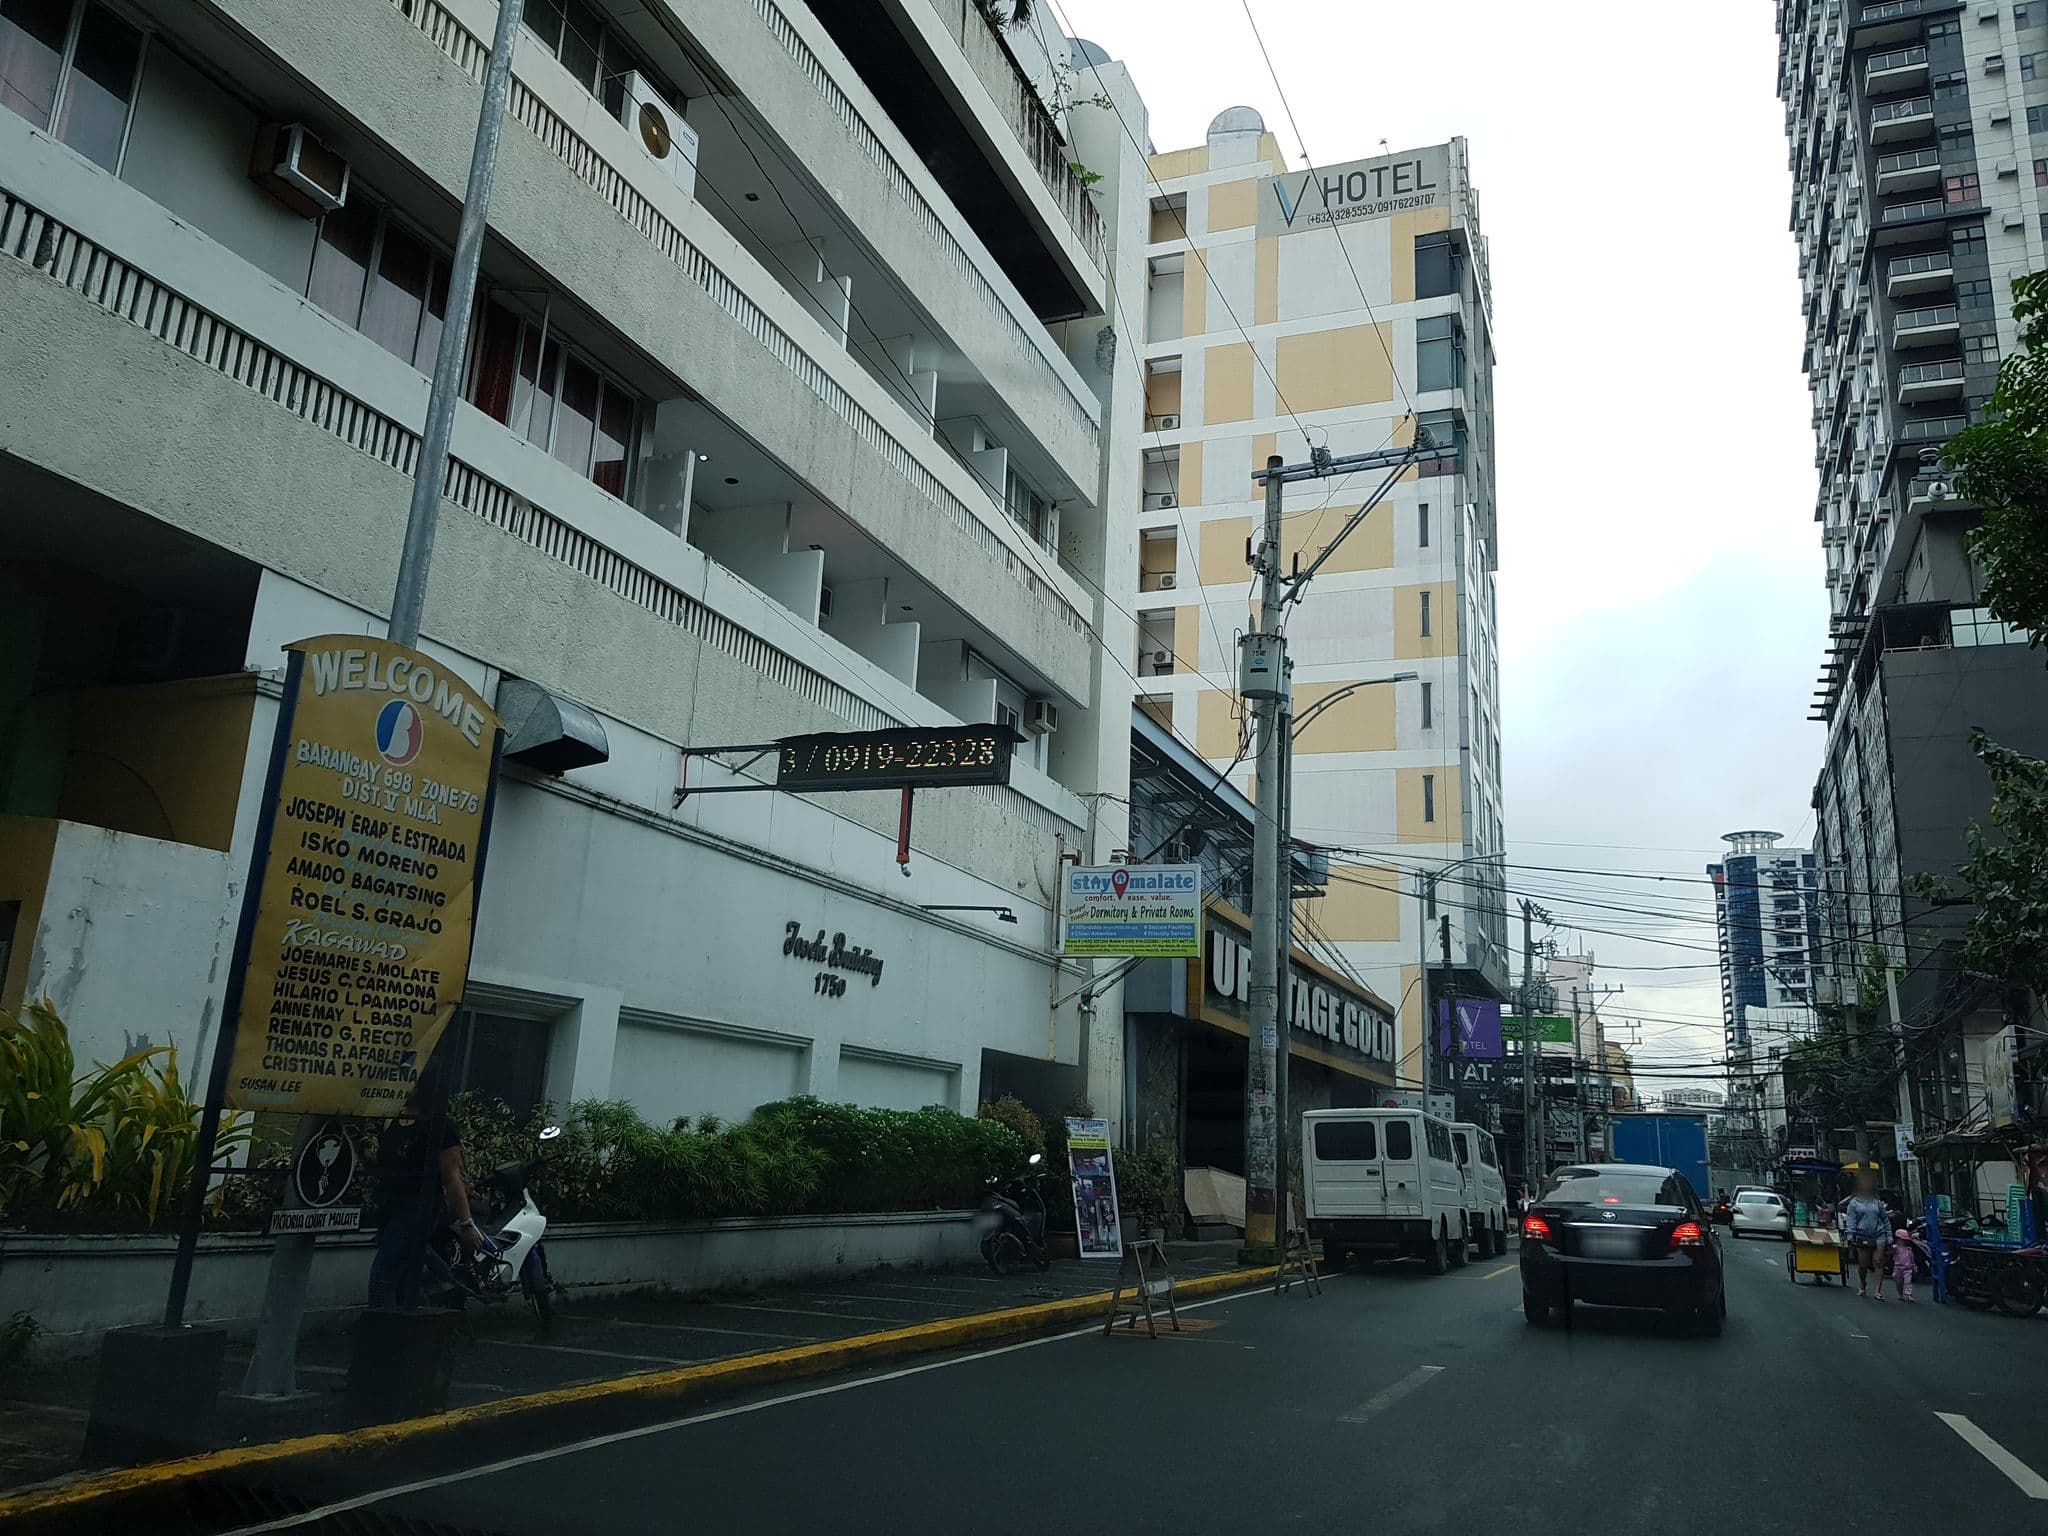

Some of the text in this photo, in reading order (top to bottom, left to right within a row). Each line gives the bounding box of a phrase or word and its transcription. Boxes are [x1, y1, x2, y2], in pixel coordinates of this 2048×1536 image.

[1272, 160, 1436, 228] V HOTEL
[312, 649, 486, 748] WELCOME
[296, 739, 381, 783] BARANGAY
[383, 769, 413, 794] 698
[285, 797, 346, 829] JOSEPH
[343, 777, 381, 808] DIST.
[404, 797, 442, 825] MLA.
[301, 831, 439, 880] ISKO MORENO
[286, 857, 447, 907] AMADO BAGATSING
[1072, 873, 1194, 892] stay malate
[290, 886, 442, 935] ROEL S. GRAJO
[1090, 905, 1194, 922] Dormitory & Private Rooms
[281, 918, 408, 961] KAGAWAD
[281, 946, 360, 972] JOEMARIE
[273, 981, 339, 1004] HILARIO
[361, 993, 437, 1016] PAMPOLA
[277, 965, 332, 985] JESUS
[356, 975, 437, 1001] CARMONA
[813, 971, 847, 998] 1750
[268, 1017, 333, 1039] RENATO
[359, 1028, 413, 1047] RECTO
[371, 1011, 413, 1029] BASA
[1343, 1001, 1393, 1063] GOLD
[266, 1036, 328, 1058] THOMAS
[262, 1054, 336, 1076] CRISTINA
[239, 1077, 302, 1093] SUSAN LEE
[272, 1212, 359, 1230] VICTORIA COURT MALATE
